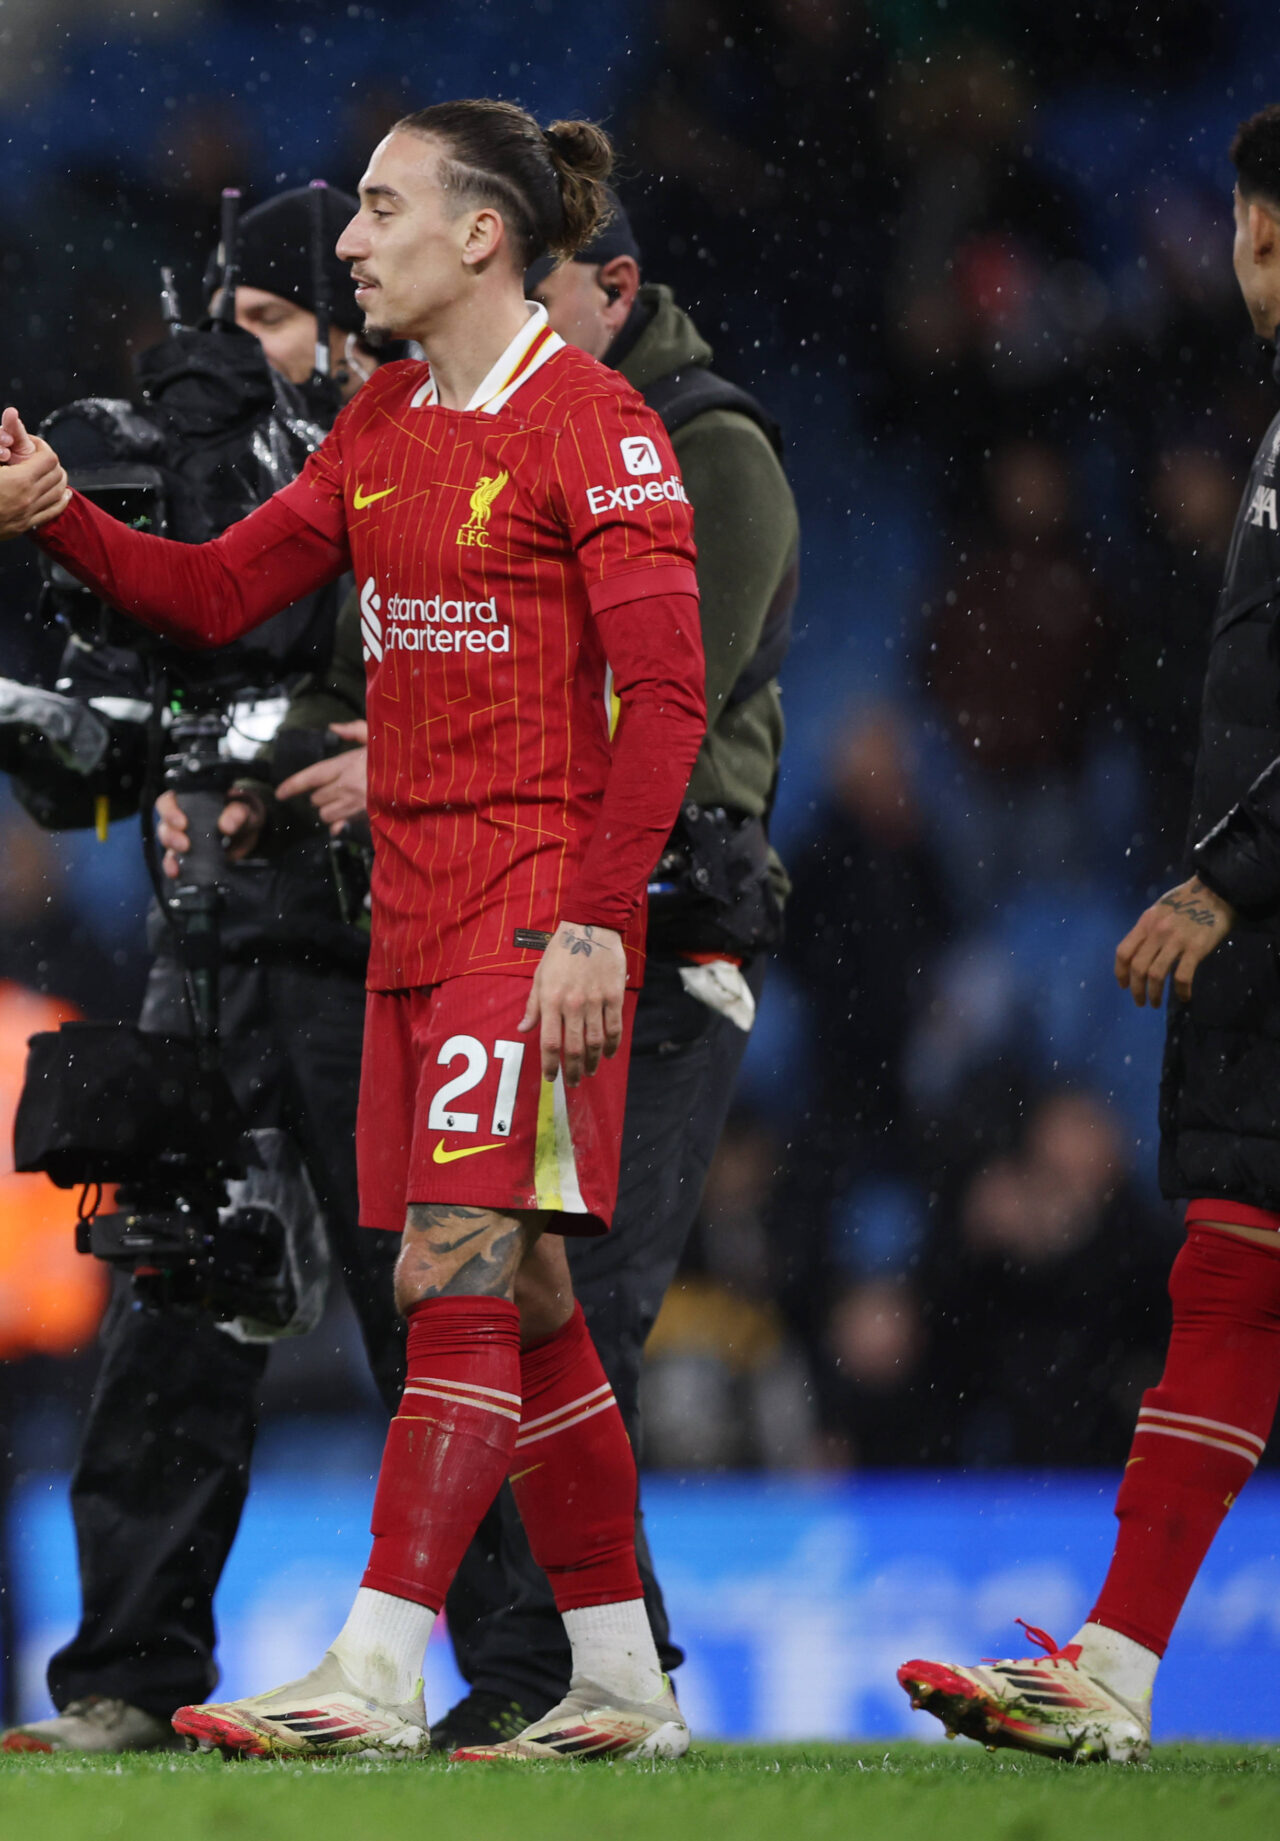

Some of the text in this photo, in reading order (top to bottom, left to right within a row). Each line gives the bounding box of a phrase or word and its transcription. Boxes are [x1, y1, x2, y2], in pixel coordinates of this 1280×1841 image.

[386, 592, 498, 623] standard
[385, 622, 510, 653] chartered
[427, 1034, 526, 1137] 21
